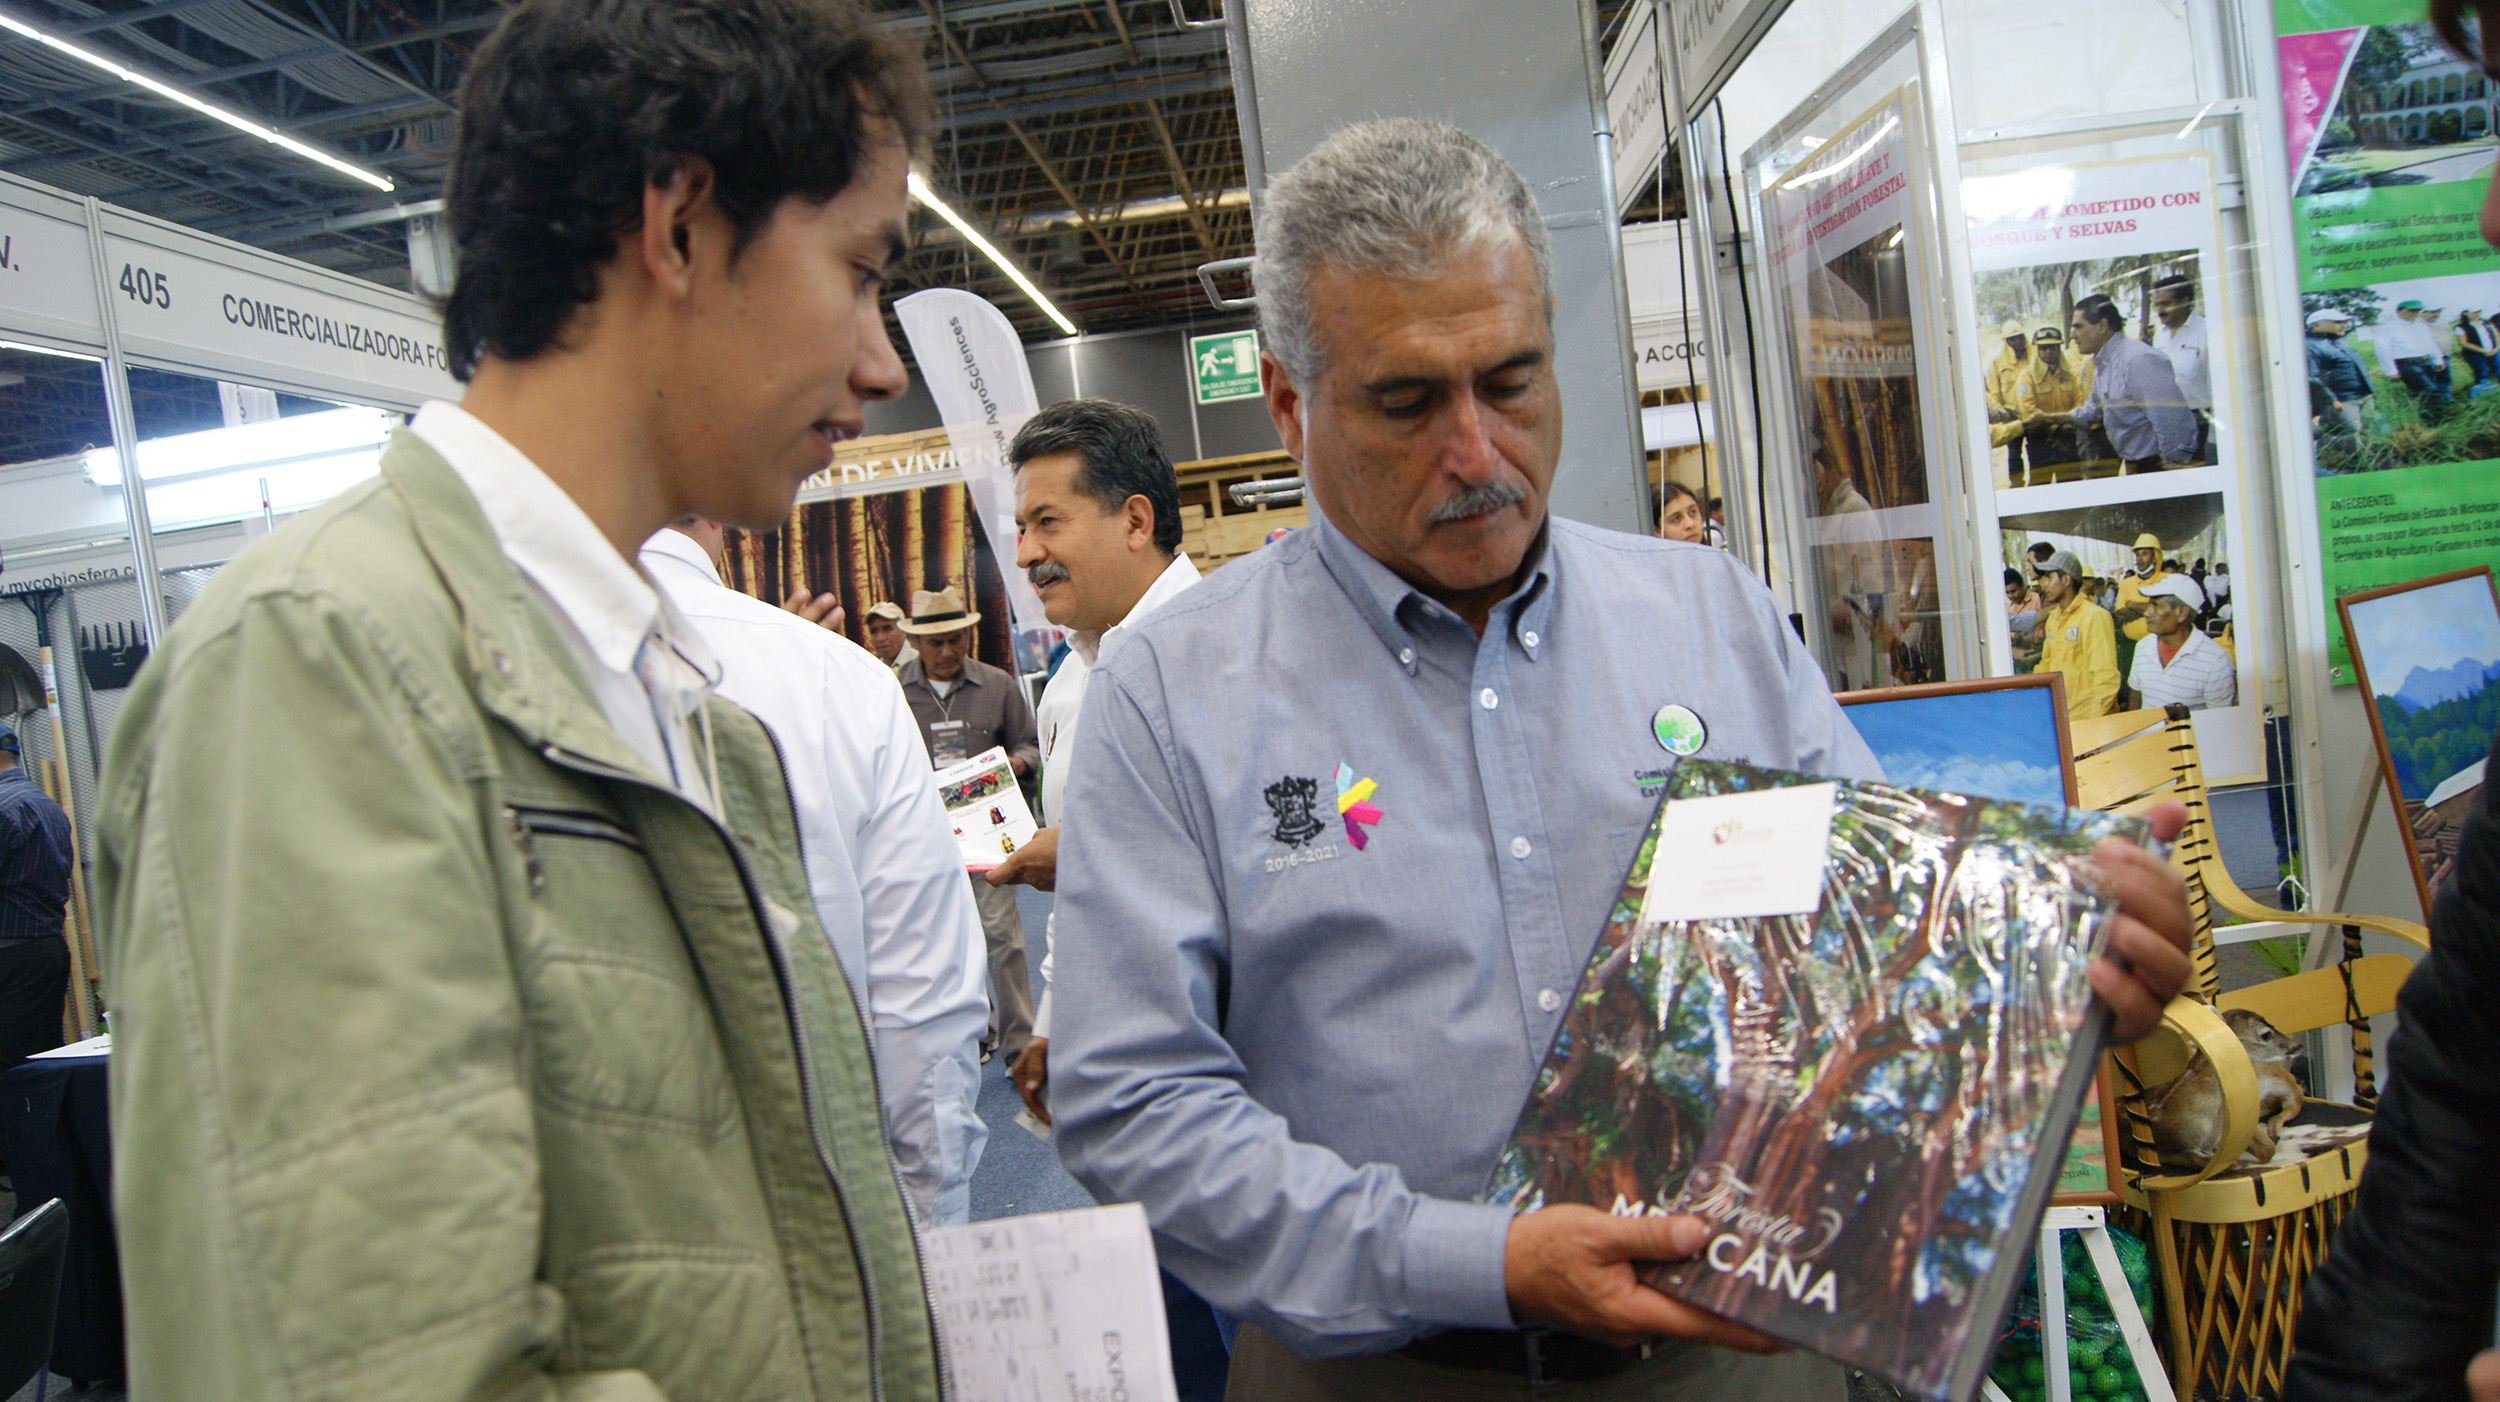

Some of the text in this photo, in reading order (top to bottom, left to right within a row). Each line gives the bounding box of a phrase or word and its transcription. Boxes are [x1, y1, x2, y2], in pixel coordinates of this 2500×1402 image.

[1862, 172, 1907, 212] FORESTAL
[2162, 191, 2202, 208] CON
[2052, 226, 2063, 240] Y
[2069, 219, 2138, 238] SELVAS
[119, 263, 171, 310] 405
[222, 293, 425, 366] COMERCIALIZADORA
[949, 316, 999, 426] AgroSciences
[1610, 1192, 1838, 1314] MCANA
